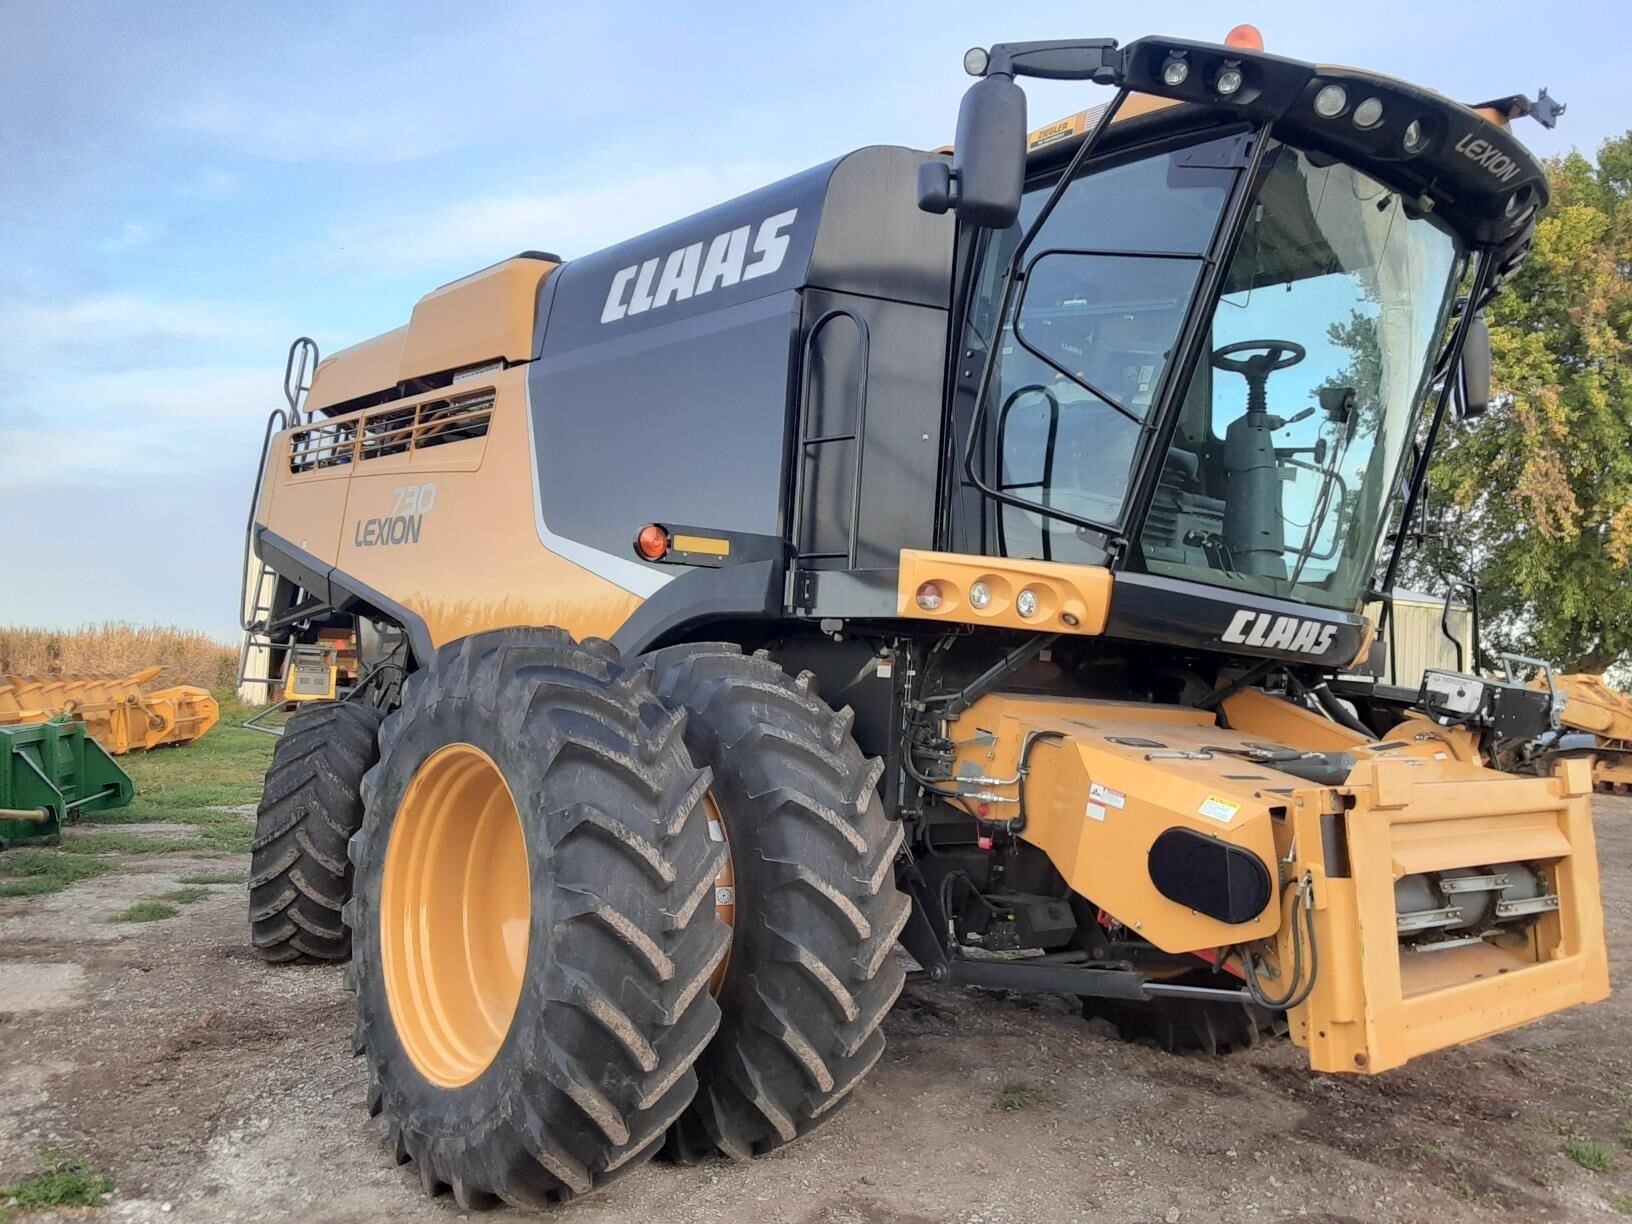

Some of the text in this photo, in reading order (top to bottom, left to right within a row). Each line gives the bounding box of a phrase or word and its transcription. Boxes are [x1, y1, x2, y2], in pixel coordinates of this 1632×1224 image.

[1038, 122, 1069, 139] ZIEGLER
[1455, 132, 1521, 183] LEXION
[600, 208, 799, 324] CLAAS
[392, 483, 436, 515] 730
[355, 514, 423, 547] LEXION
[1221, 609, 1338, 655] CLAAS
